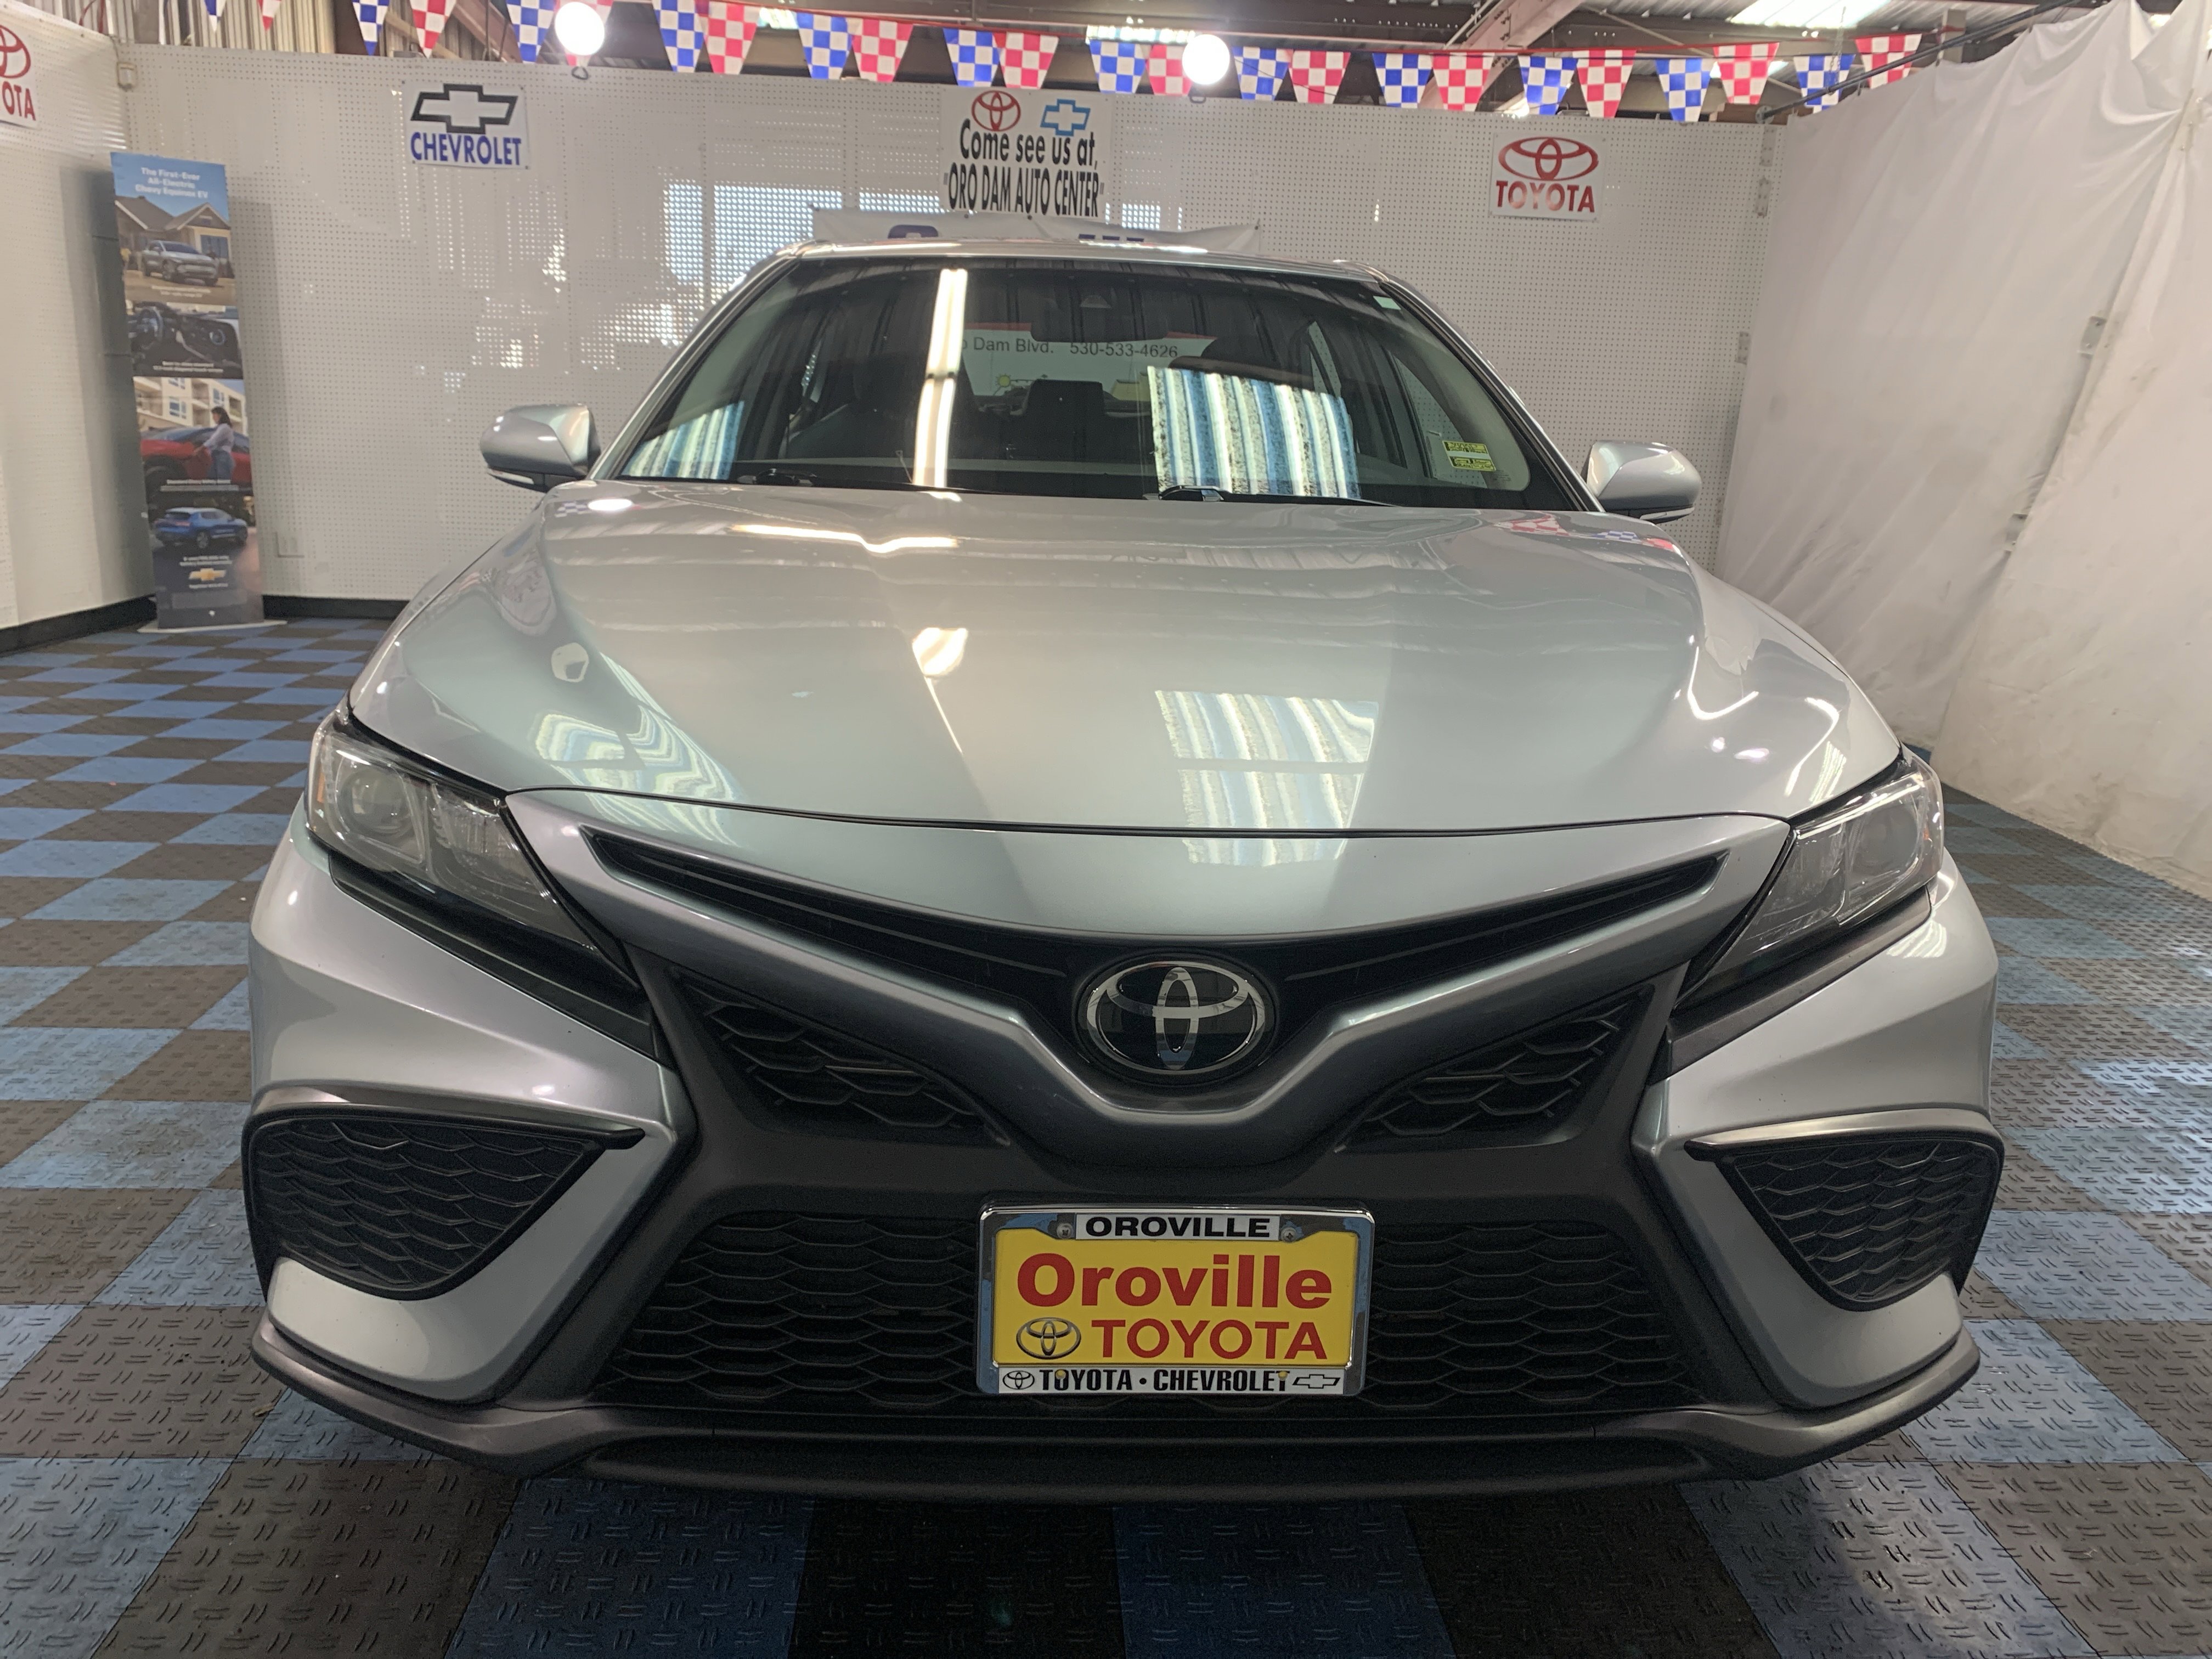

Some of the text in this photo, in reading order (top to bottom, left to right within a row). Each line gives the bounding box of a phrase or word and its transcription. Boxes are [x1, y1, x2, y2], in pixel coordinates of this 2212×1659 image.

[2, 81, 36, 121] OTA
[411, 131, 521, 165] CHEVROLET
[960, 118, 1009, 161] Come
[1016, 134, 1045, 163] see
[1052, 137, 1070, 165] us
[982, 165, 1011, 212] DAM
[1015, 167, 1050, 215] AUTO
[1496, 180, 1595, 213] TOYOTA
[974, 337, 1009, 352] Dam
[1016, 338, 1054, 353] Blvd.
[1070, 342, 1178, 358] 530-533-4626
[1086, 1217, 1271, 1238] OROVILLE
[1017, 1253, 1332, 1309] Oroville
[1092, 1318, 1328, 1360] TOYOTA
[1040, 1369, 1290, 1392] TOYOTA CHEVROLET
